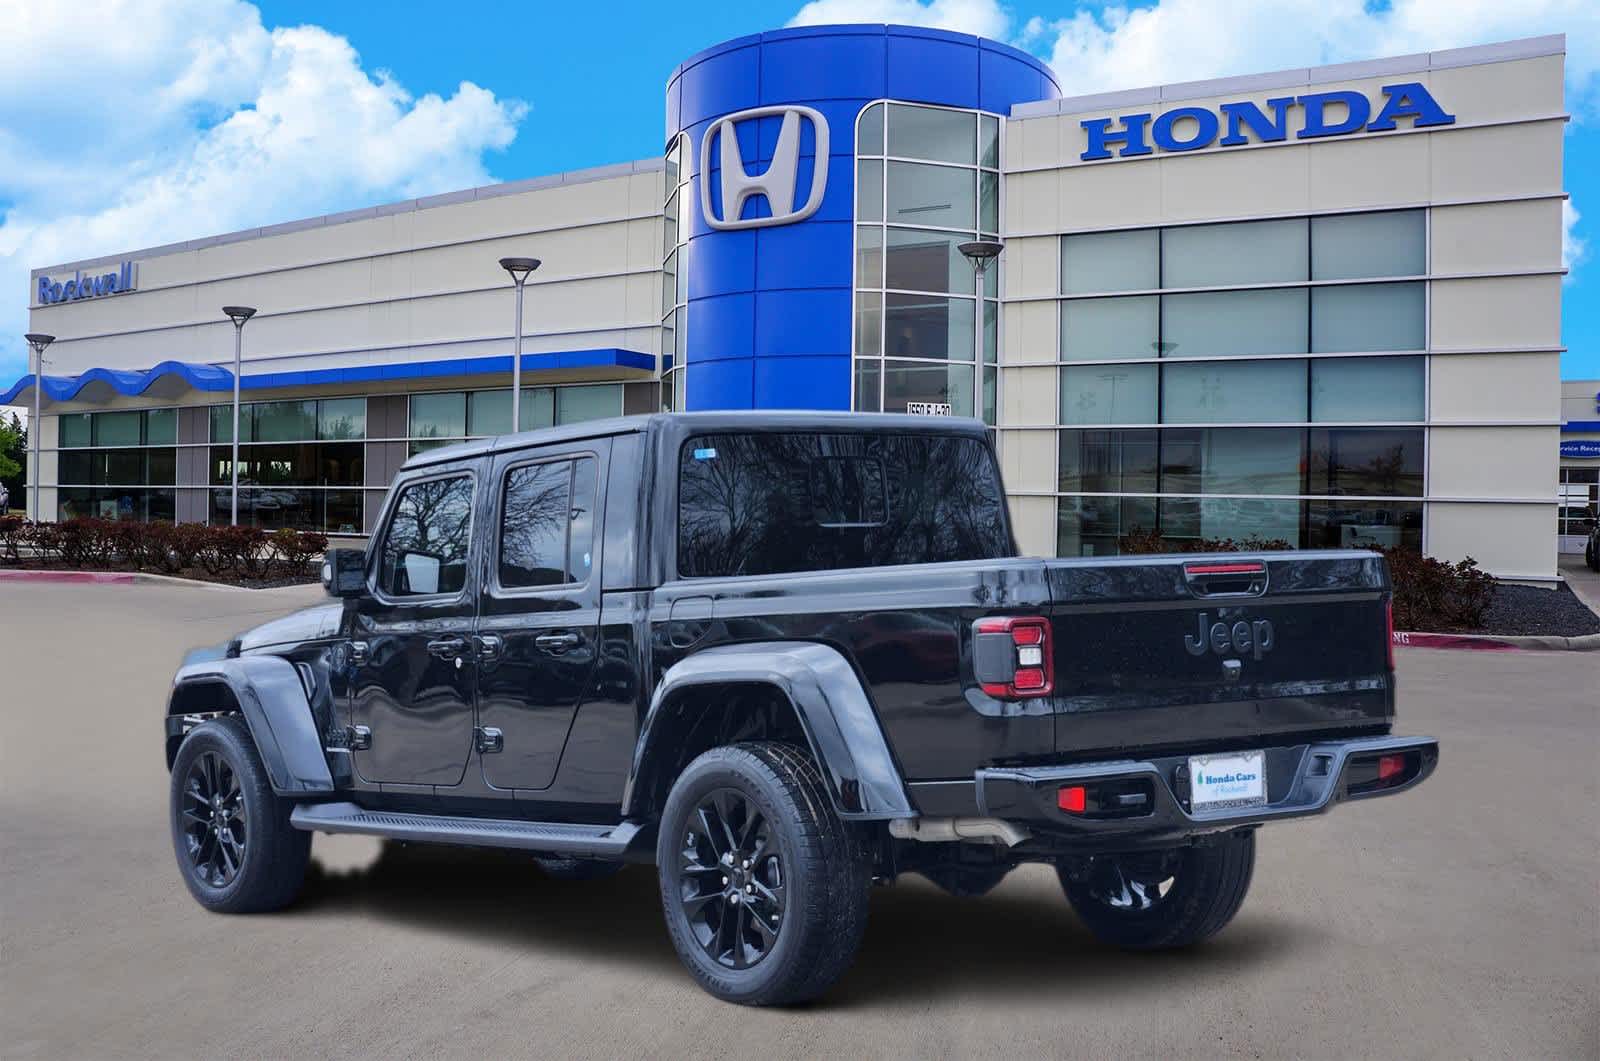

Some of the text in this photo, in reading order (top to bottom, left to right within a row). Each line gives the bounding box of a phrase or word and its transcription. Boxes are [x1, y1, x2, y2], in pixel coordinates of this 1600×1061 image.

[1080, 82, 1456, 161] HONDA
[38, 261, 133, 304] Rockwell
[1185, 612, 1274, 660] Jeep
[1206, 772, 1256, 784] Honda Cars
